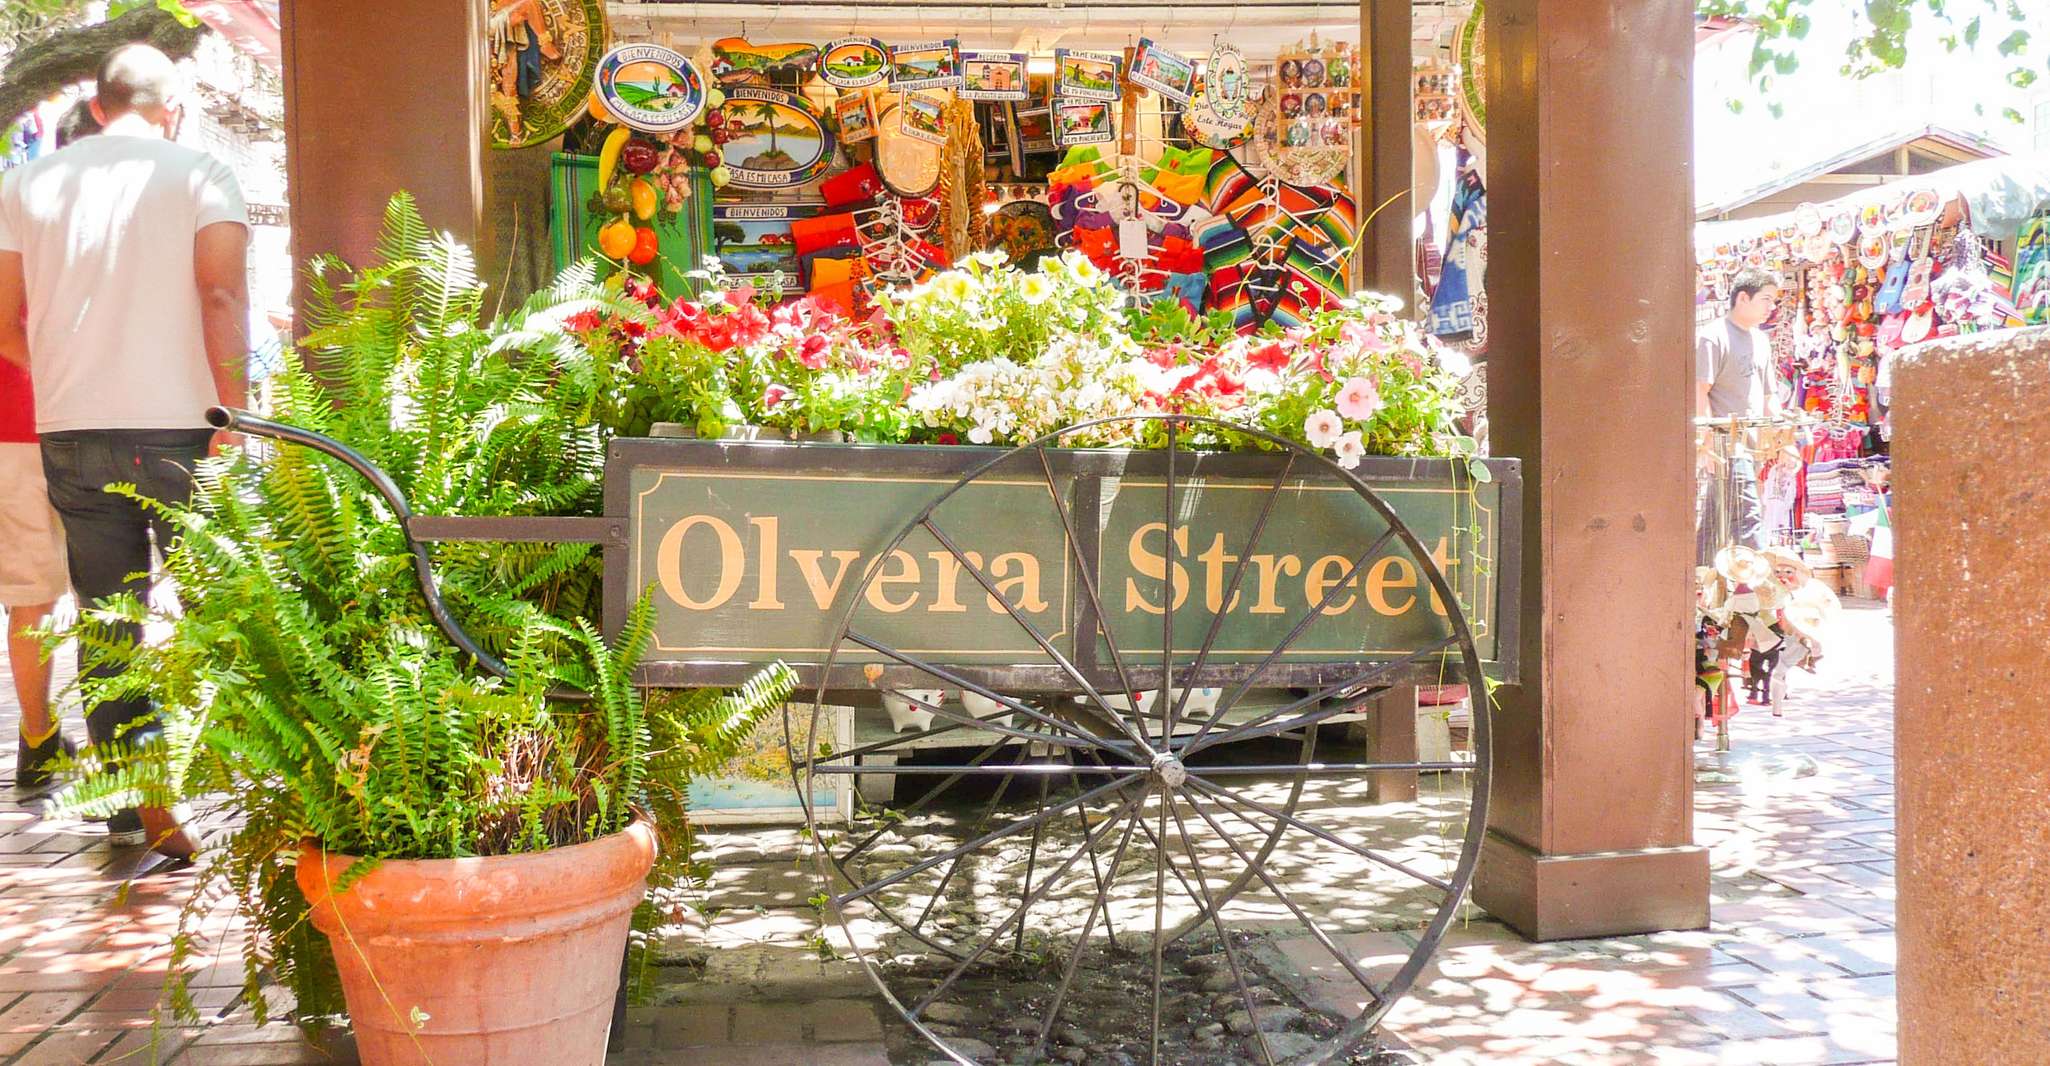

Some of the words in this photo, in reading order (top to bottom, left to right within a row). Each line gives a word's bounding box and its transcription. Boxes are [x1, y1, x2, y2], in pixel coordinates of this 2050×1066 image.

[622, 48, 682, 68] BIENVENIDOS
[735, 88, 785, 103] BIENVENIDOS
[767, 173, 788, 182] CASA
[730, 208, 785, 217] BIENVENIDOS
[657, 514, 1049, 613] Olvera
[1125, 522, 1462, 617] Street
